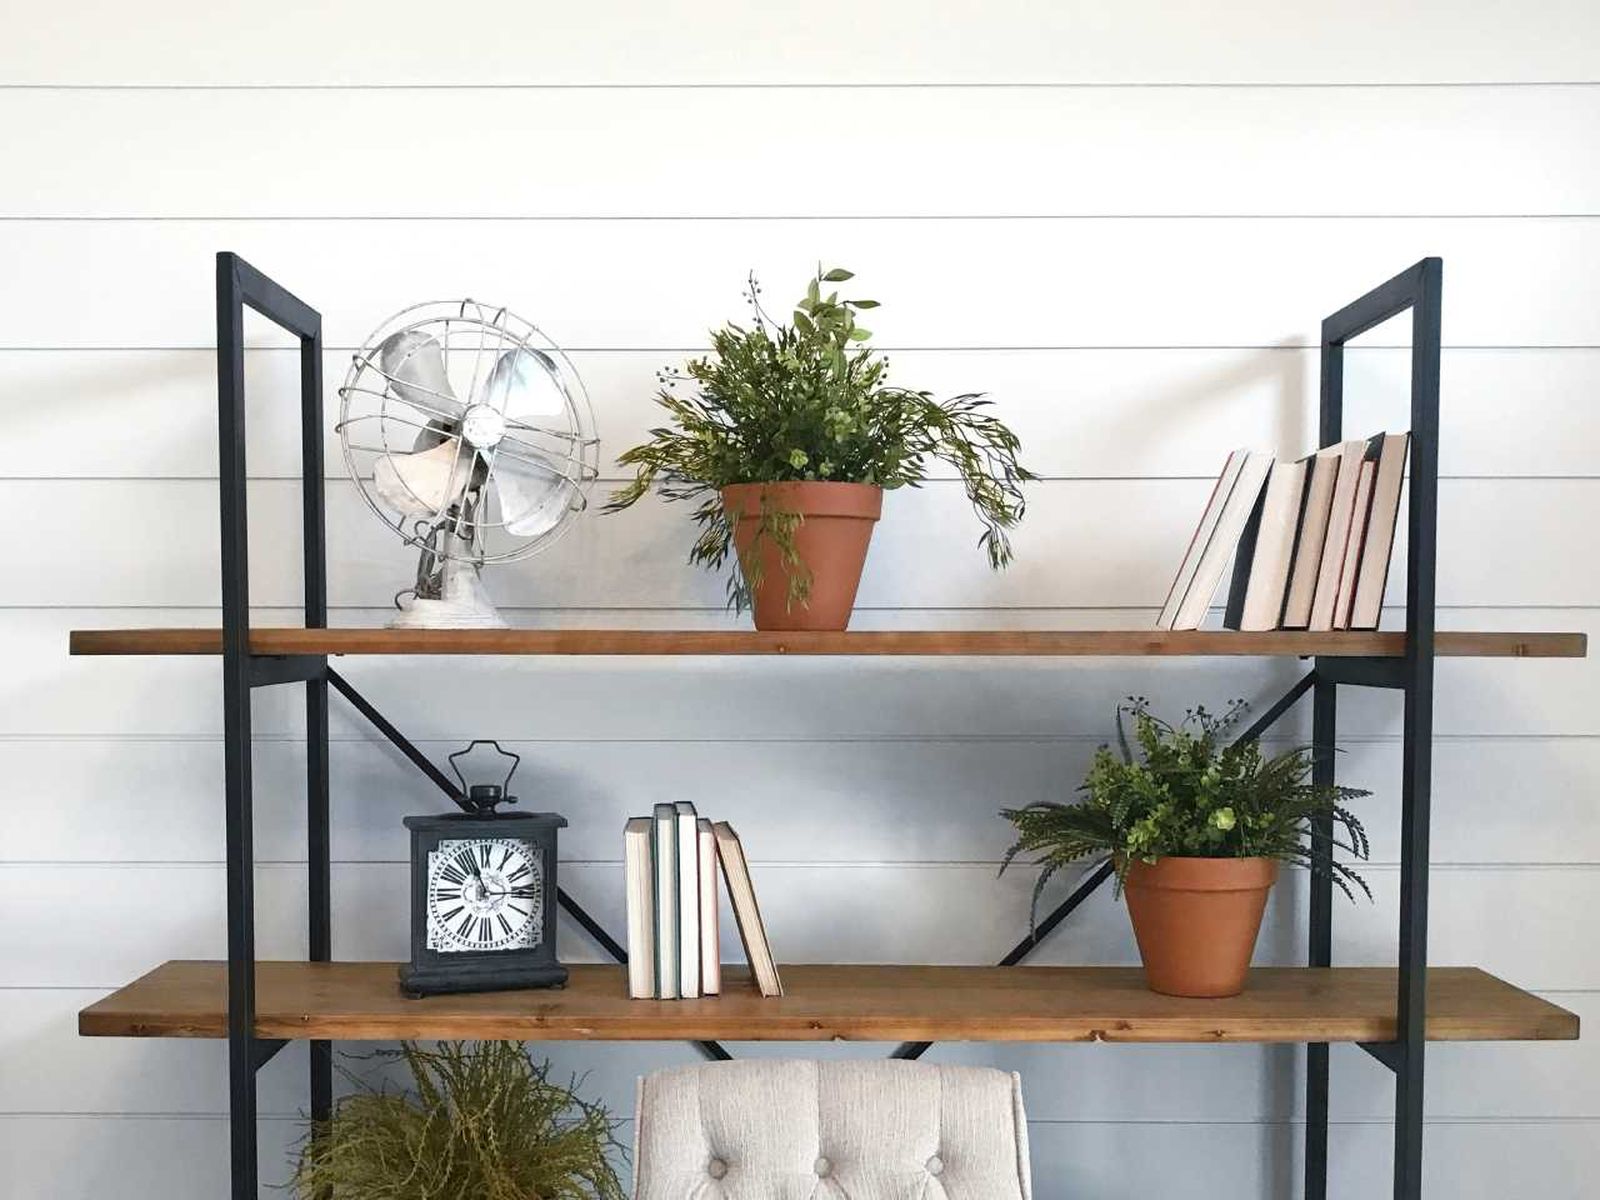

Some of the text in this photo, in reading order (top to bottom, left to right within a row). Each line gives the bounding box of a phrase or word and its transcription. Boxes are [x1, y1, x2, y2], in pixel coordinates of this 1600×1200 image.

[480, 844, 492, 869] IX
[497, 848, 514, 872] X
[506, 862, 531, 883] XI
[478, 917, 493, 942] III
[496, 913, 513, 936] II
